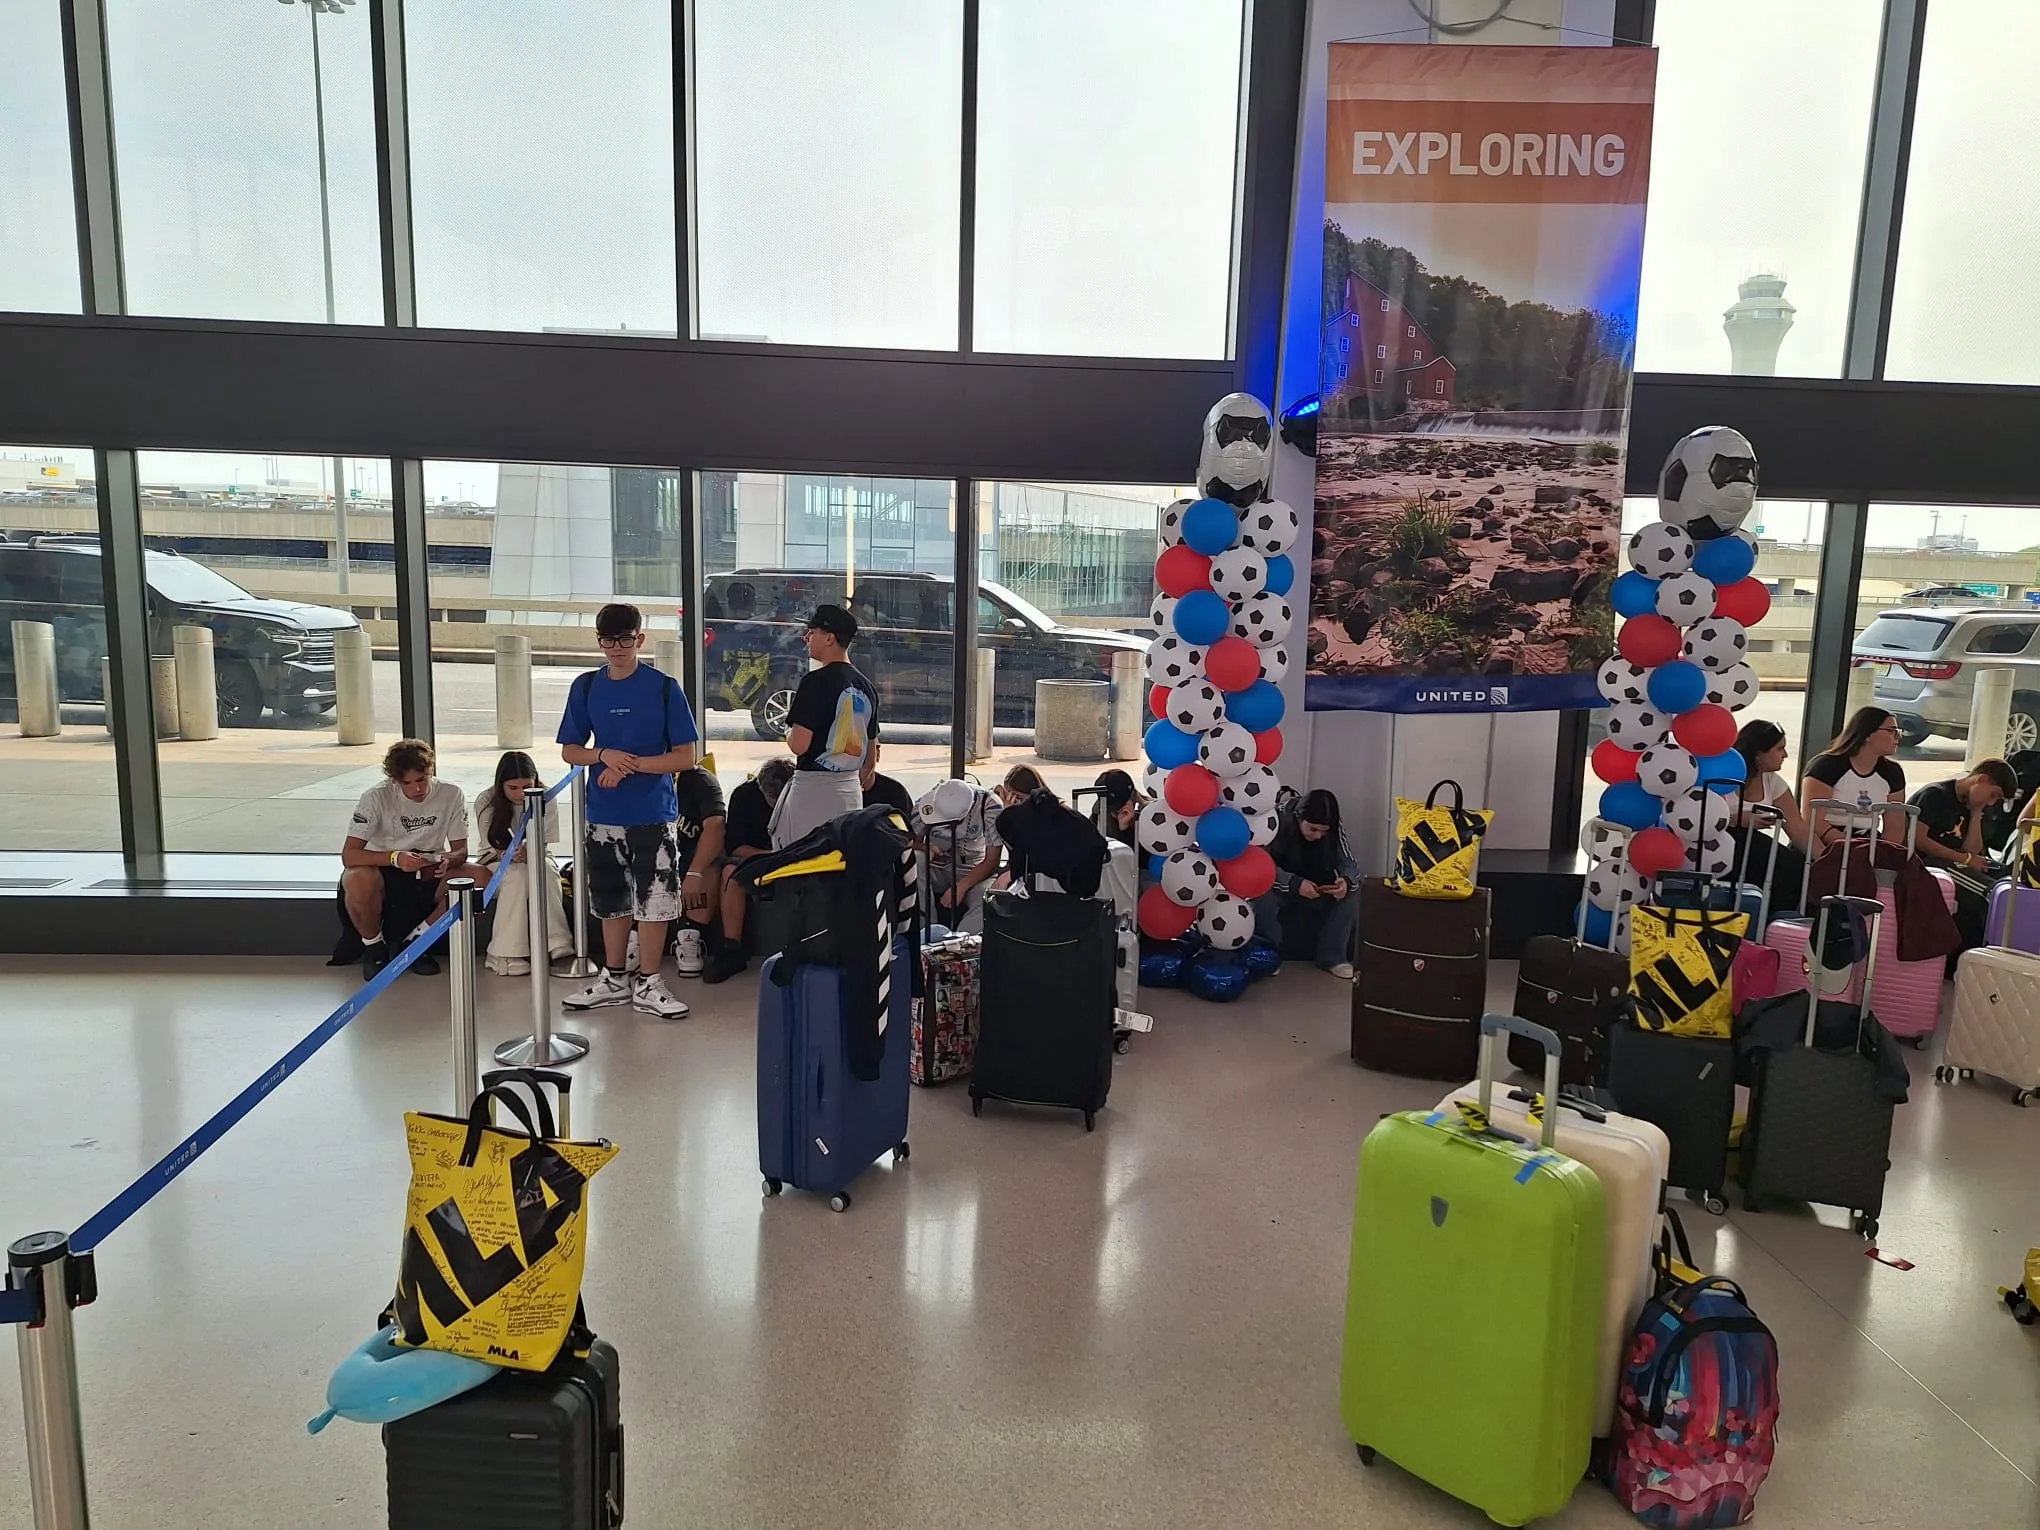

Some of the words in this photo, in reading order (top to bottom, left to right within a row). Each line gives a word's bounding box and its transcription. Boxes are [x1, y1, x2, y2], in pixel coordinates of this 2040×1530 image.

[1352, 131, 1625, 177] EXPLORING
[1416, 691, 1486, 702] UNITED
[676, 814, 700, 839] ALS
[164, 1150, 190, 1176] UNITED
[487, 1344, 520, 1361] MLA
